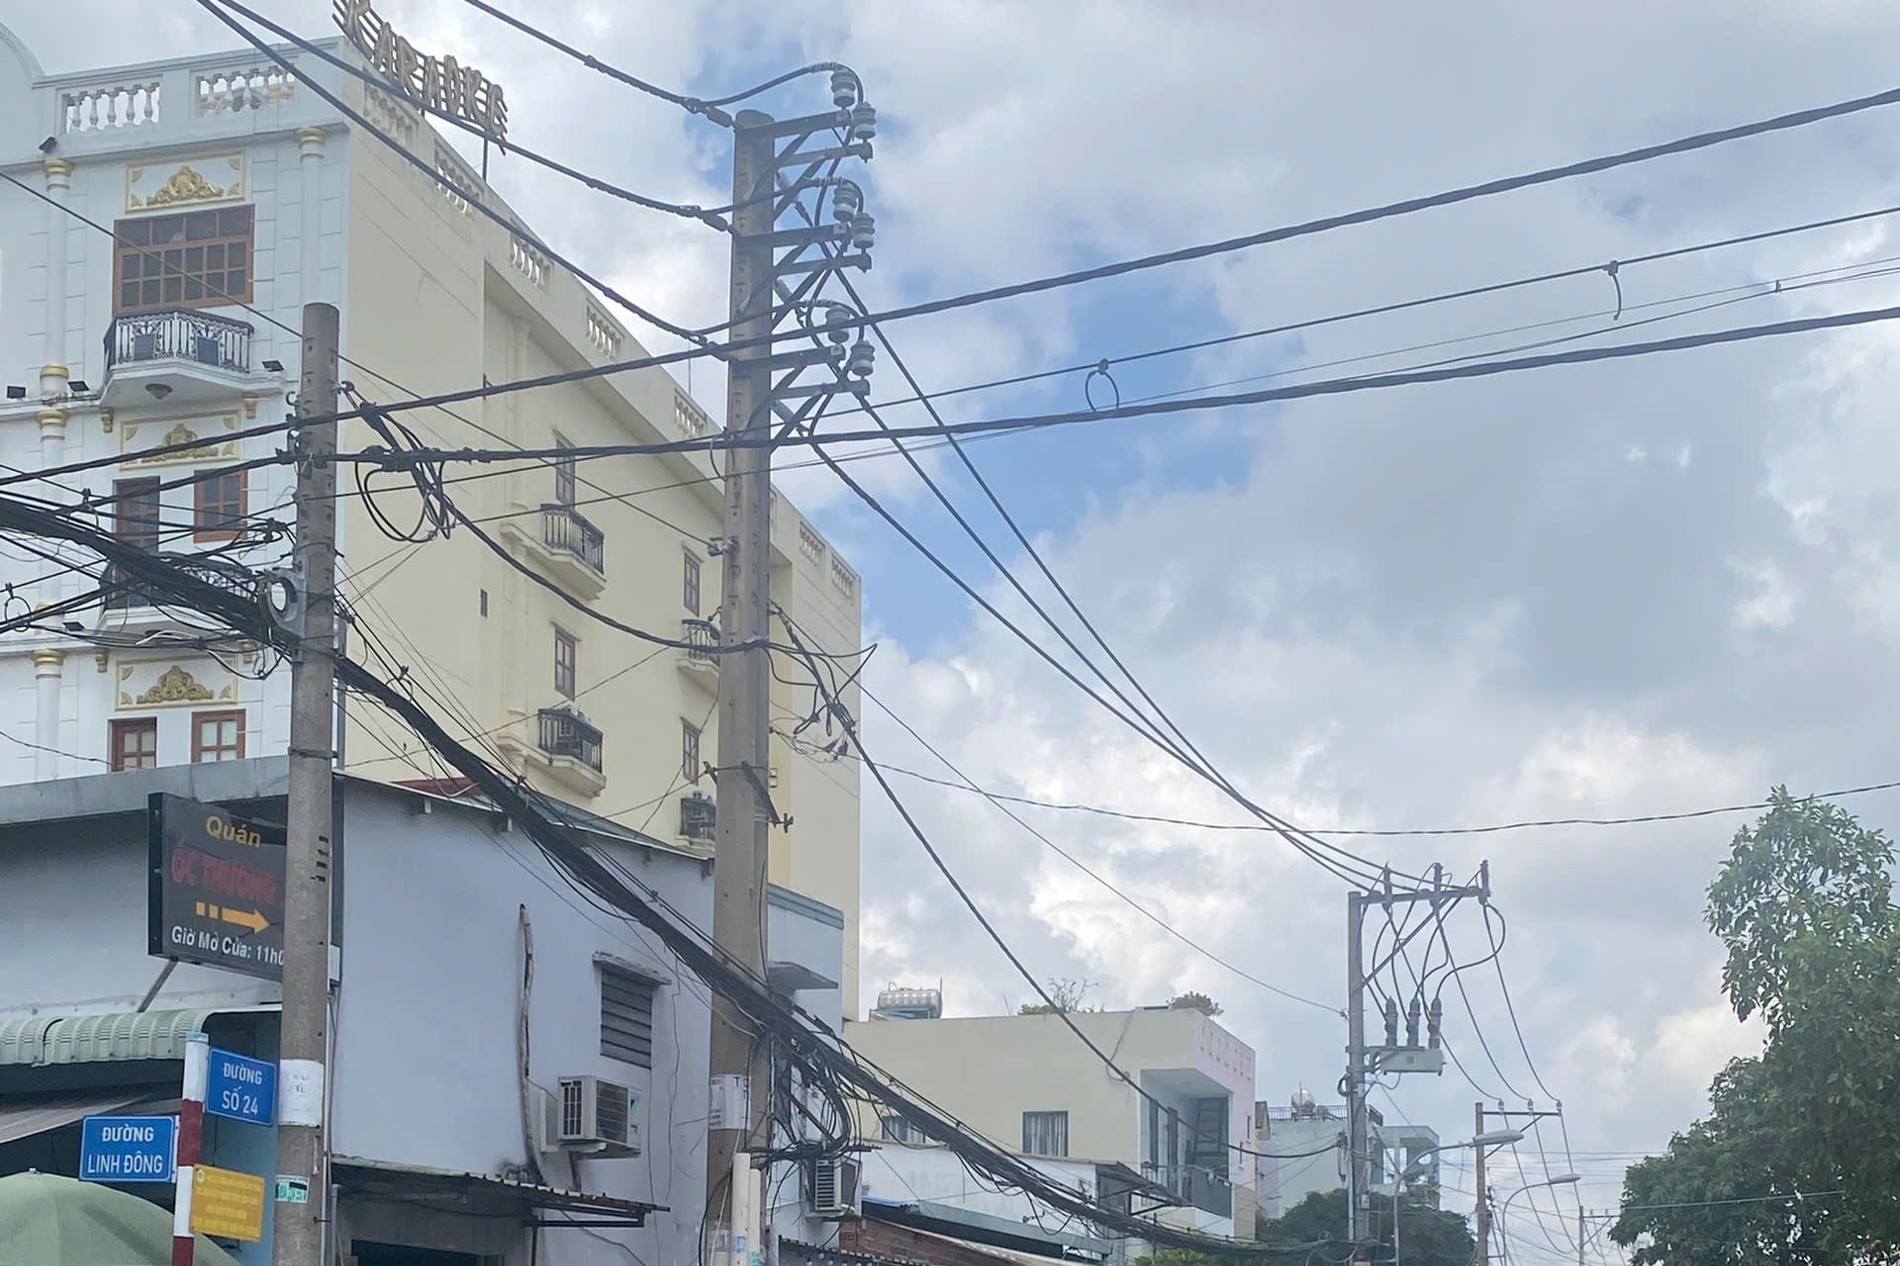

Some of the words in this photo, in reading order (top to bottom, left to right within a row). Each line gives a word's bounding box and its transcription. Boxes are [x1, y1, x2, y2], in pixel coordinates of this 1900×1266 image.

[343, 0, 503, 136] KARAOKE
[206, 815, 261, 848] Quán
[171, 925, 195, 946] Giờ
[222, 937, 252, 959] Cửa:
[223, 1062, 262, 1085] ĐƯỜNG
[221, 1085, 242, 1111] SỐ
[242, 1095, 259, 1116] 24
[102, 1123, 154, 1142] ĐƯỜNG
[87, 1154, 120, 1174] LINH
[123, 1150, 163, 1174] ĐÔNG
